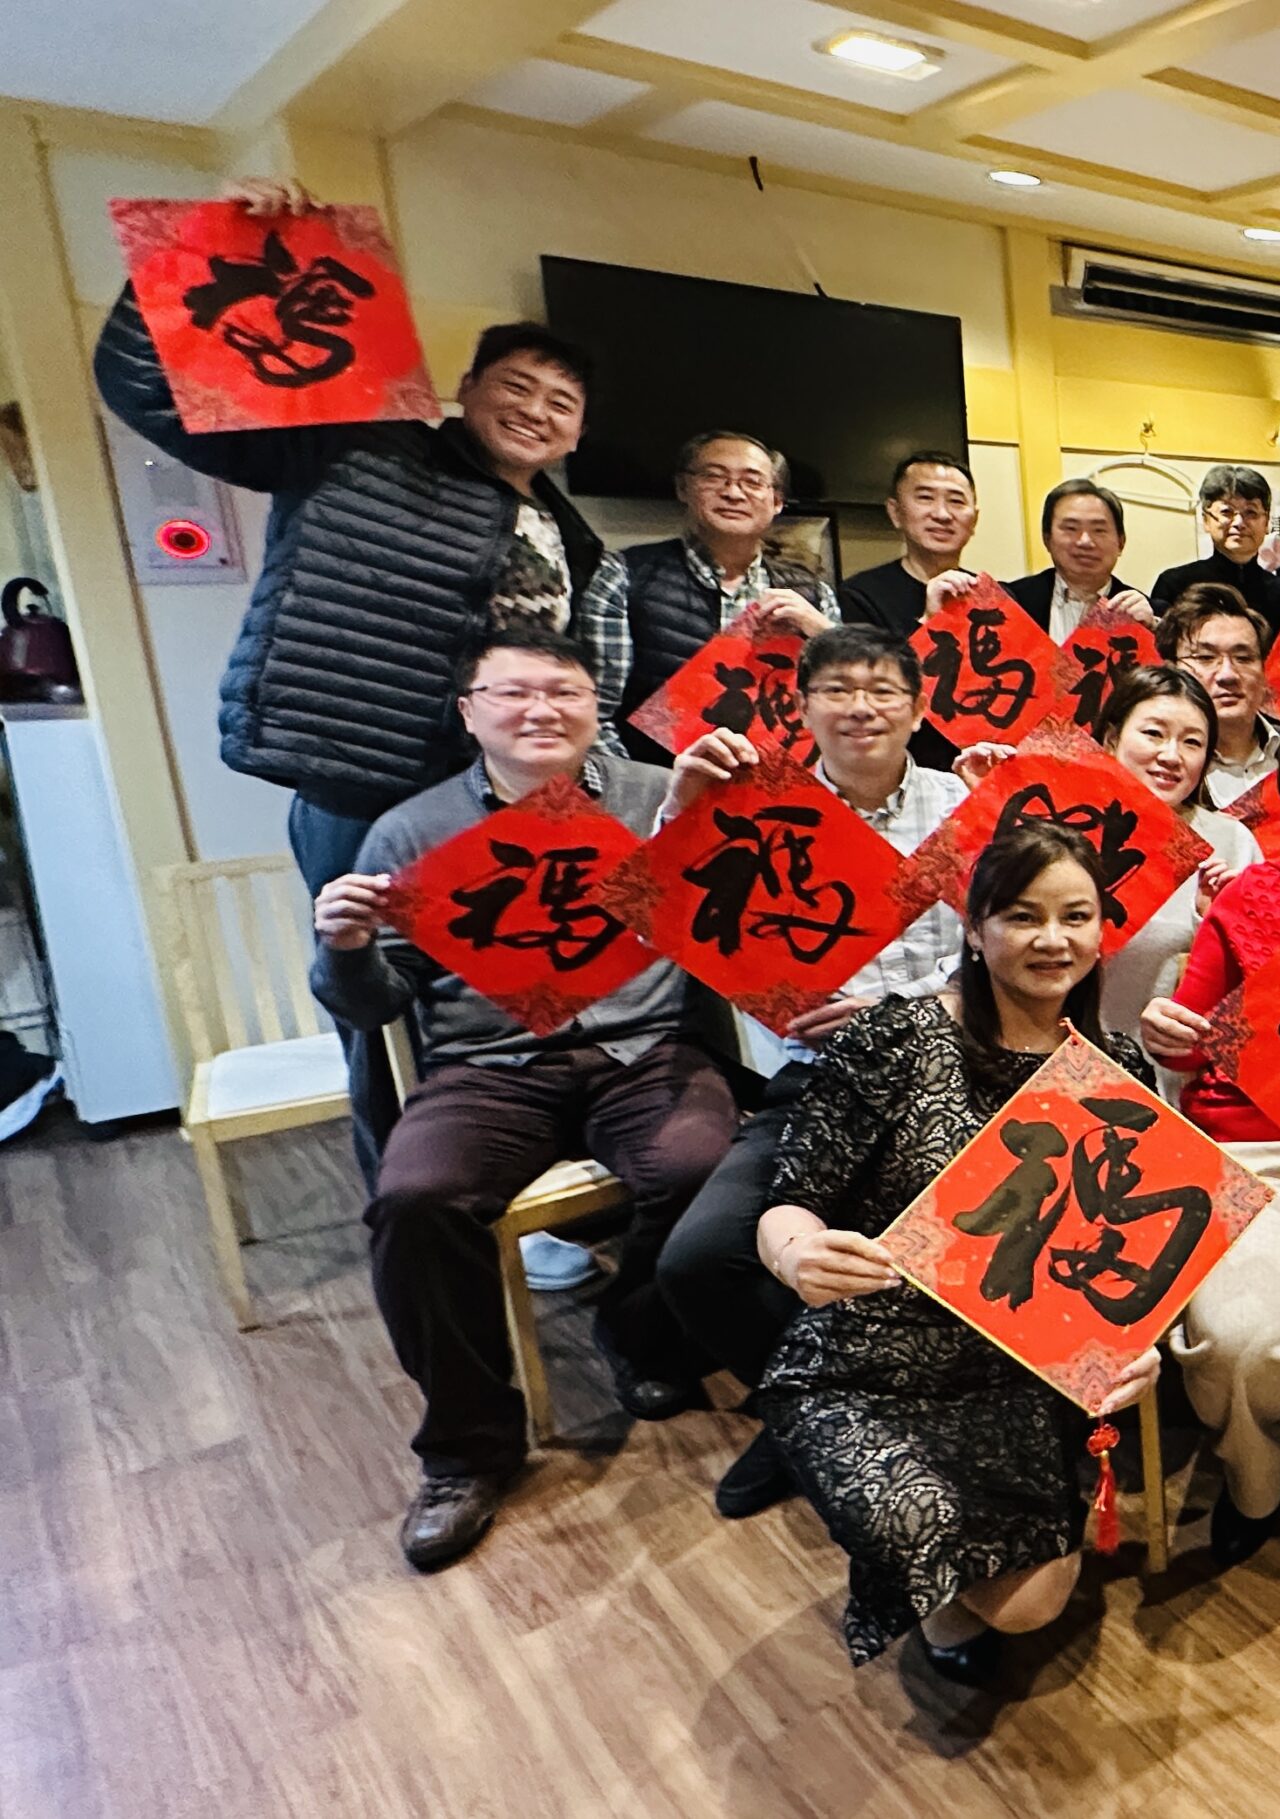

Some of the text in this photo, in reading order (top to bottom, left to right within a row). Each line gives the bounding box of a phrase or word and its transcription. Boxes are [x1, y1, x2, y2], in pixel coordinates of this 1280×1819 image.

[923, 608, 1034, 729] 福
[448, 838, 625, 972] 福
[682, 806, 870, 964] 福
[953, 1097, 1213, 1327] 福
